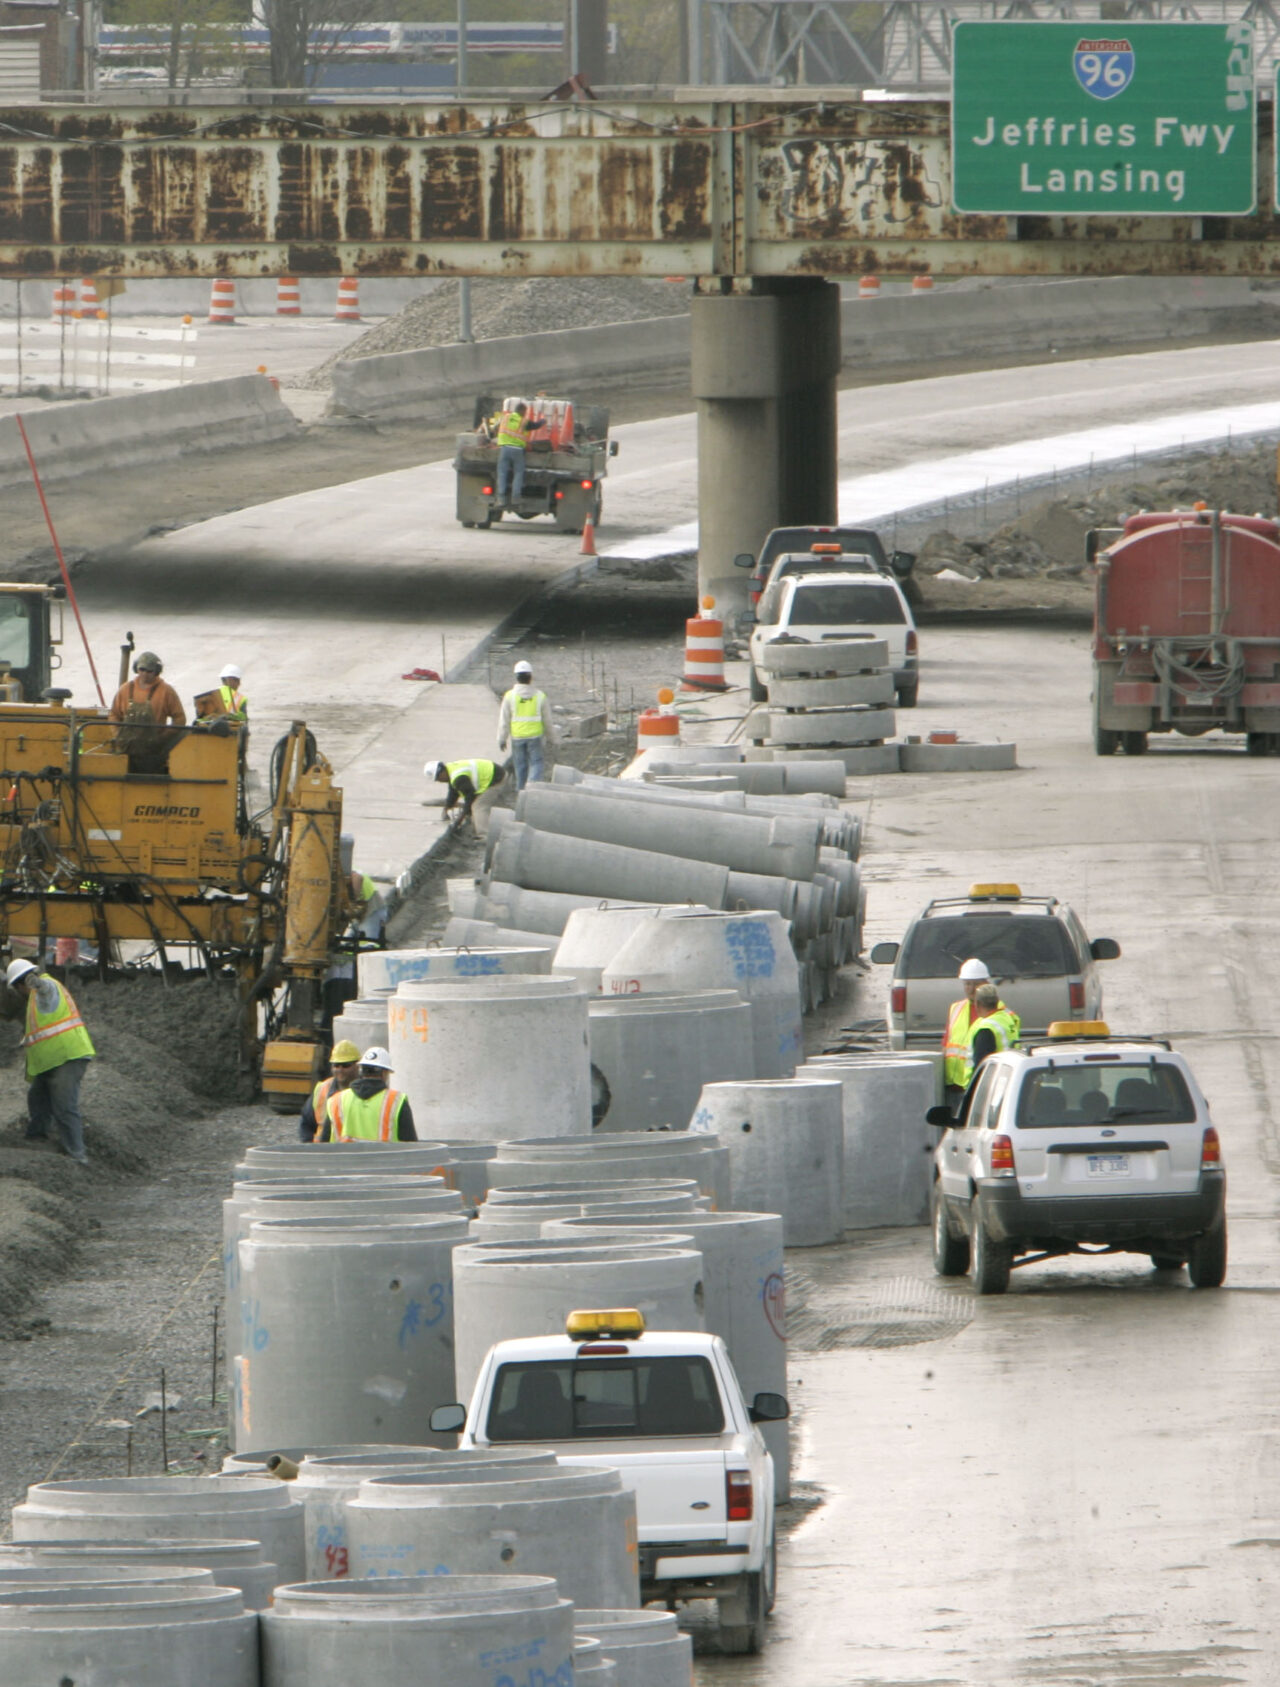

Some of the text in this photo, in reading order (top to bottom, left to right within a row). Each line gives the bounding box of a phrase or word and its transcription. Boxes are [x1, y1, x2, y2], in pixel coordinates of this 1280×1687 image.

[1080, 54, 1125, 87] 96
[973, 117, 1234, 154] Jeffries Fwy
[1021, 163, 1185, 202] Lansing
[325, 1543, 349, 1578] 43
